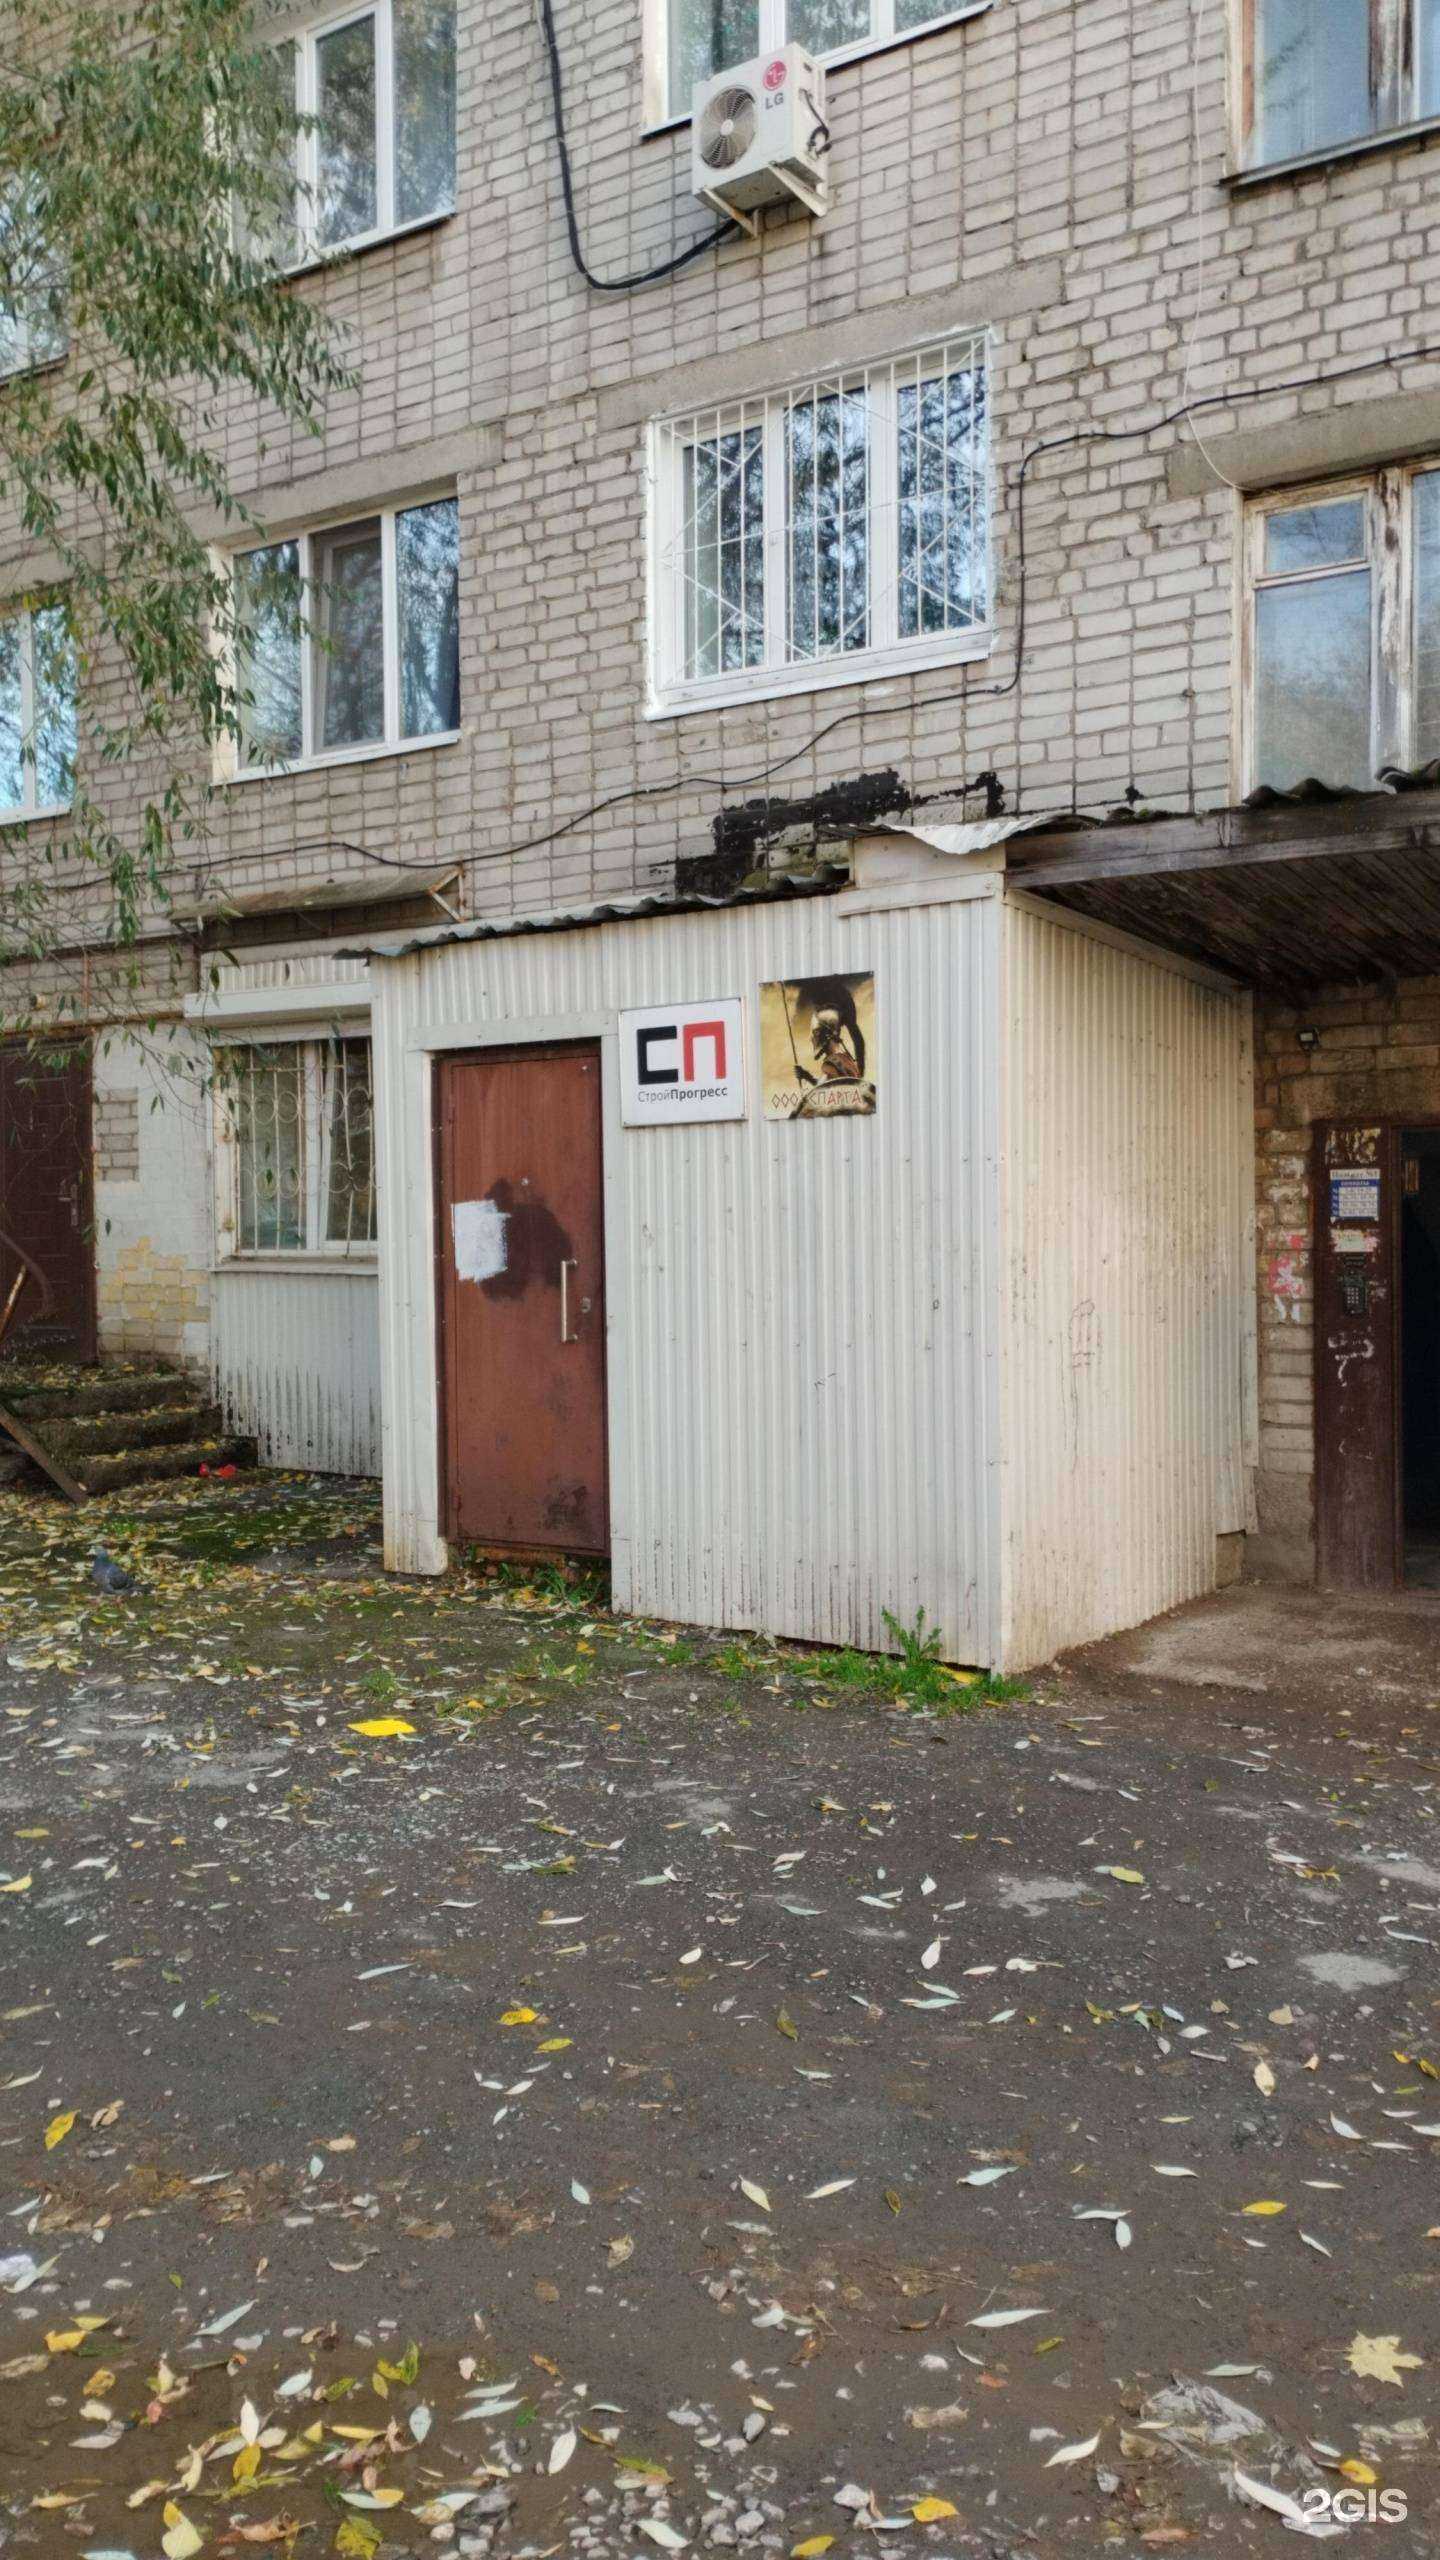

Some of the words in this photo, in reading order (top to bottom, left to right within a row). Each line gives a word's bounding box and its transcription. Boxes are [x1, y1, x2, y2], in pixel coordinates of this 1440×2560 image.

[765, 92, 784, 110] LG
[636, 1020, 727, 1086] СП
[637, 1087, 728, 1104] СтройПрогресс
